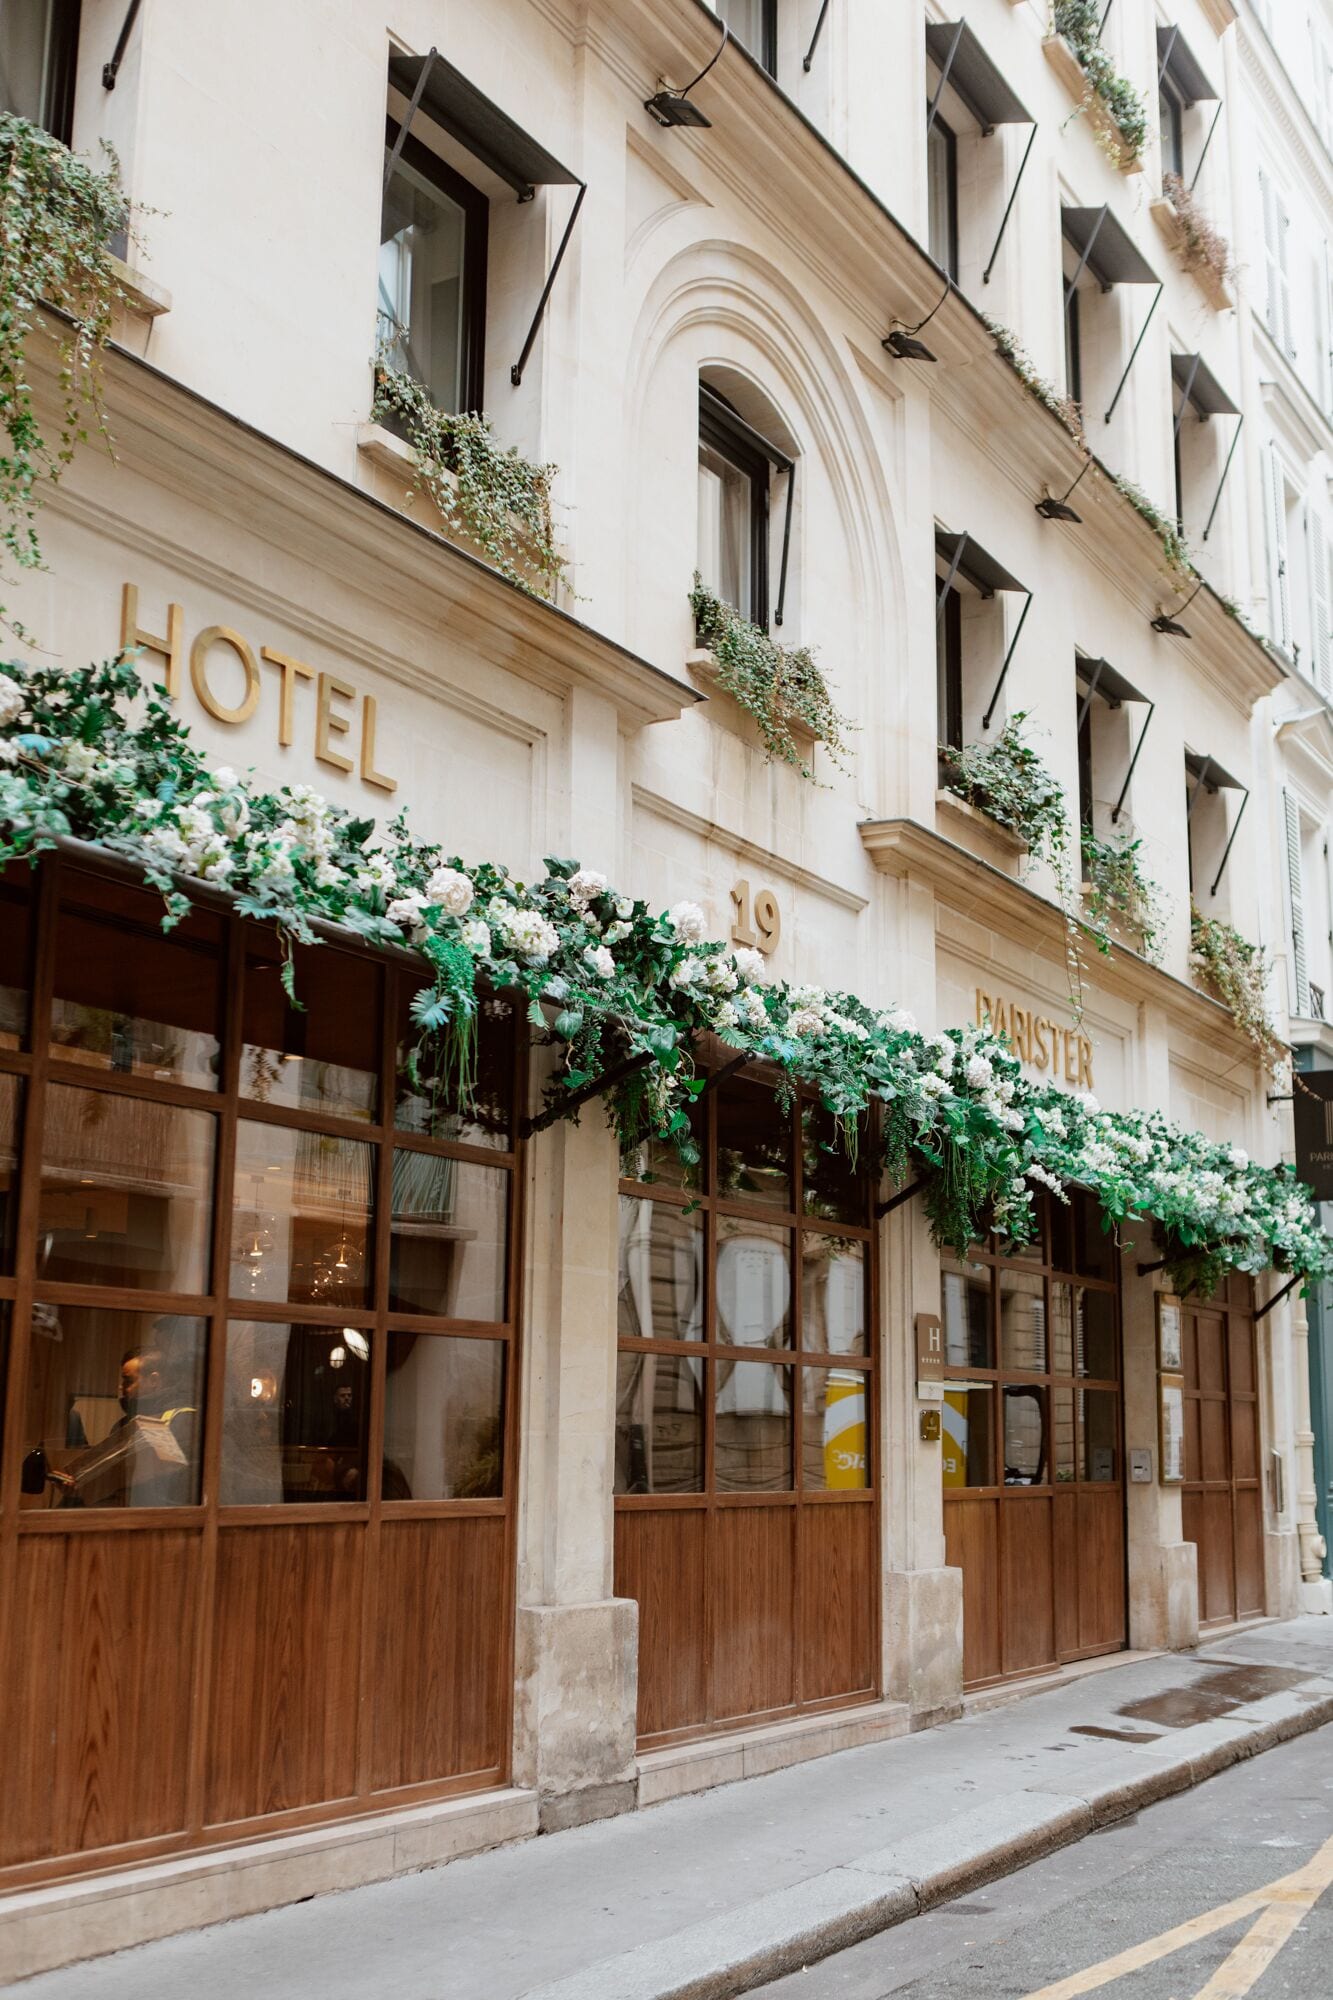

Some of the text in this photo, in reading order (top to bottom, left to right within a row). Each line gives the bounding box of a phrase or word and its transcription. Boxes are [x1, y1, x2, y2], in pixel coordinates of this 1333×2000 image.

[120, 582, 398, 793] HOTEL
[730, 879, 780, 955] 19
[929, 1327, 941, 1352] H
